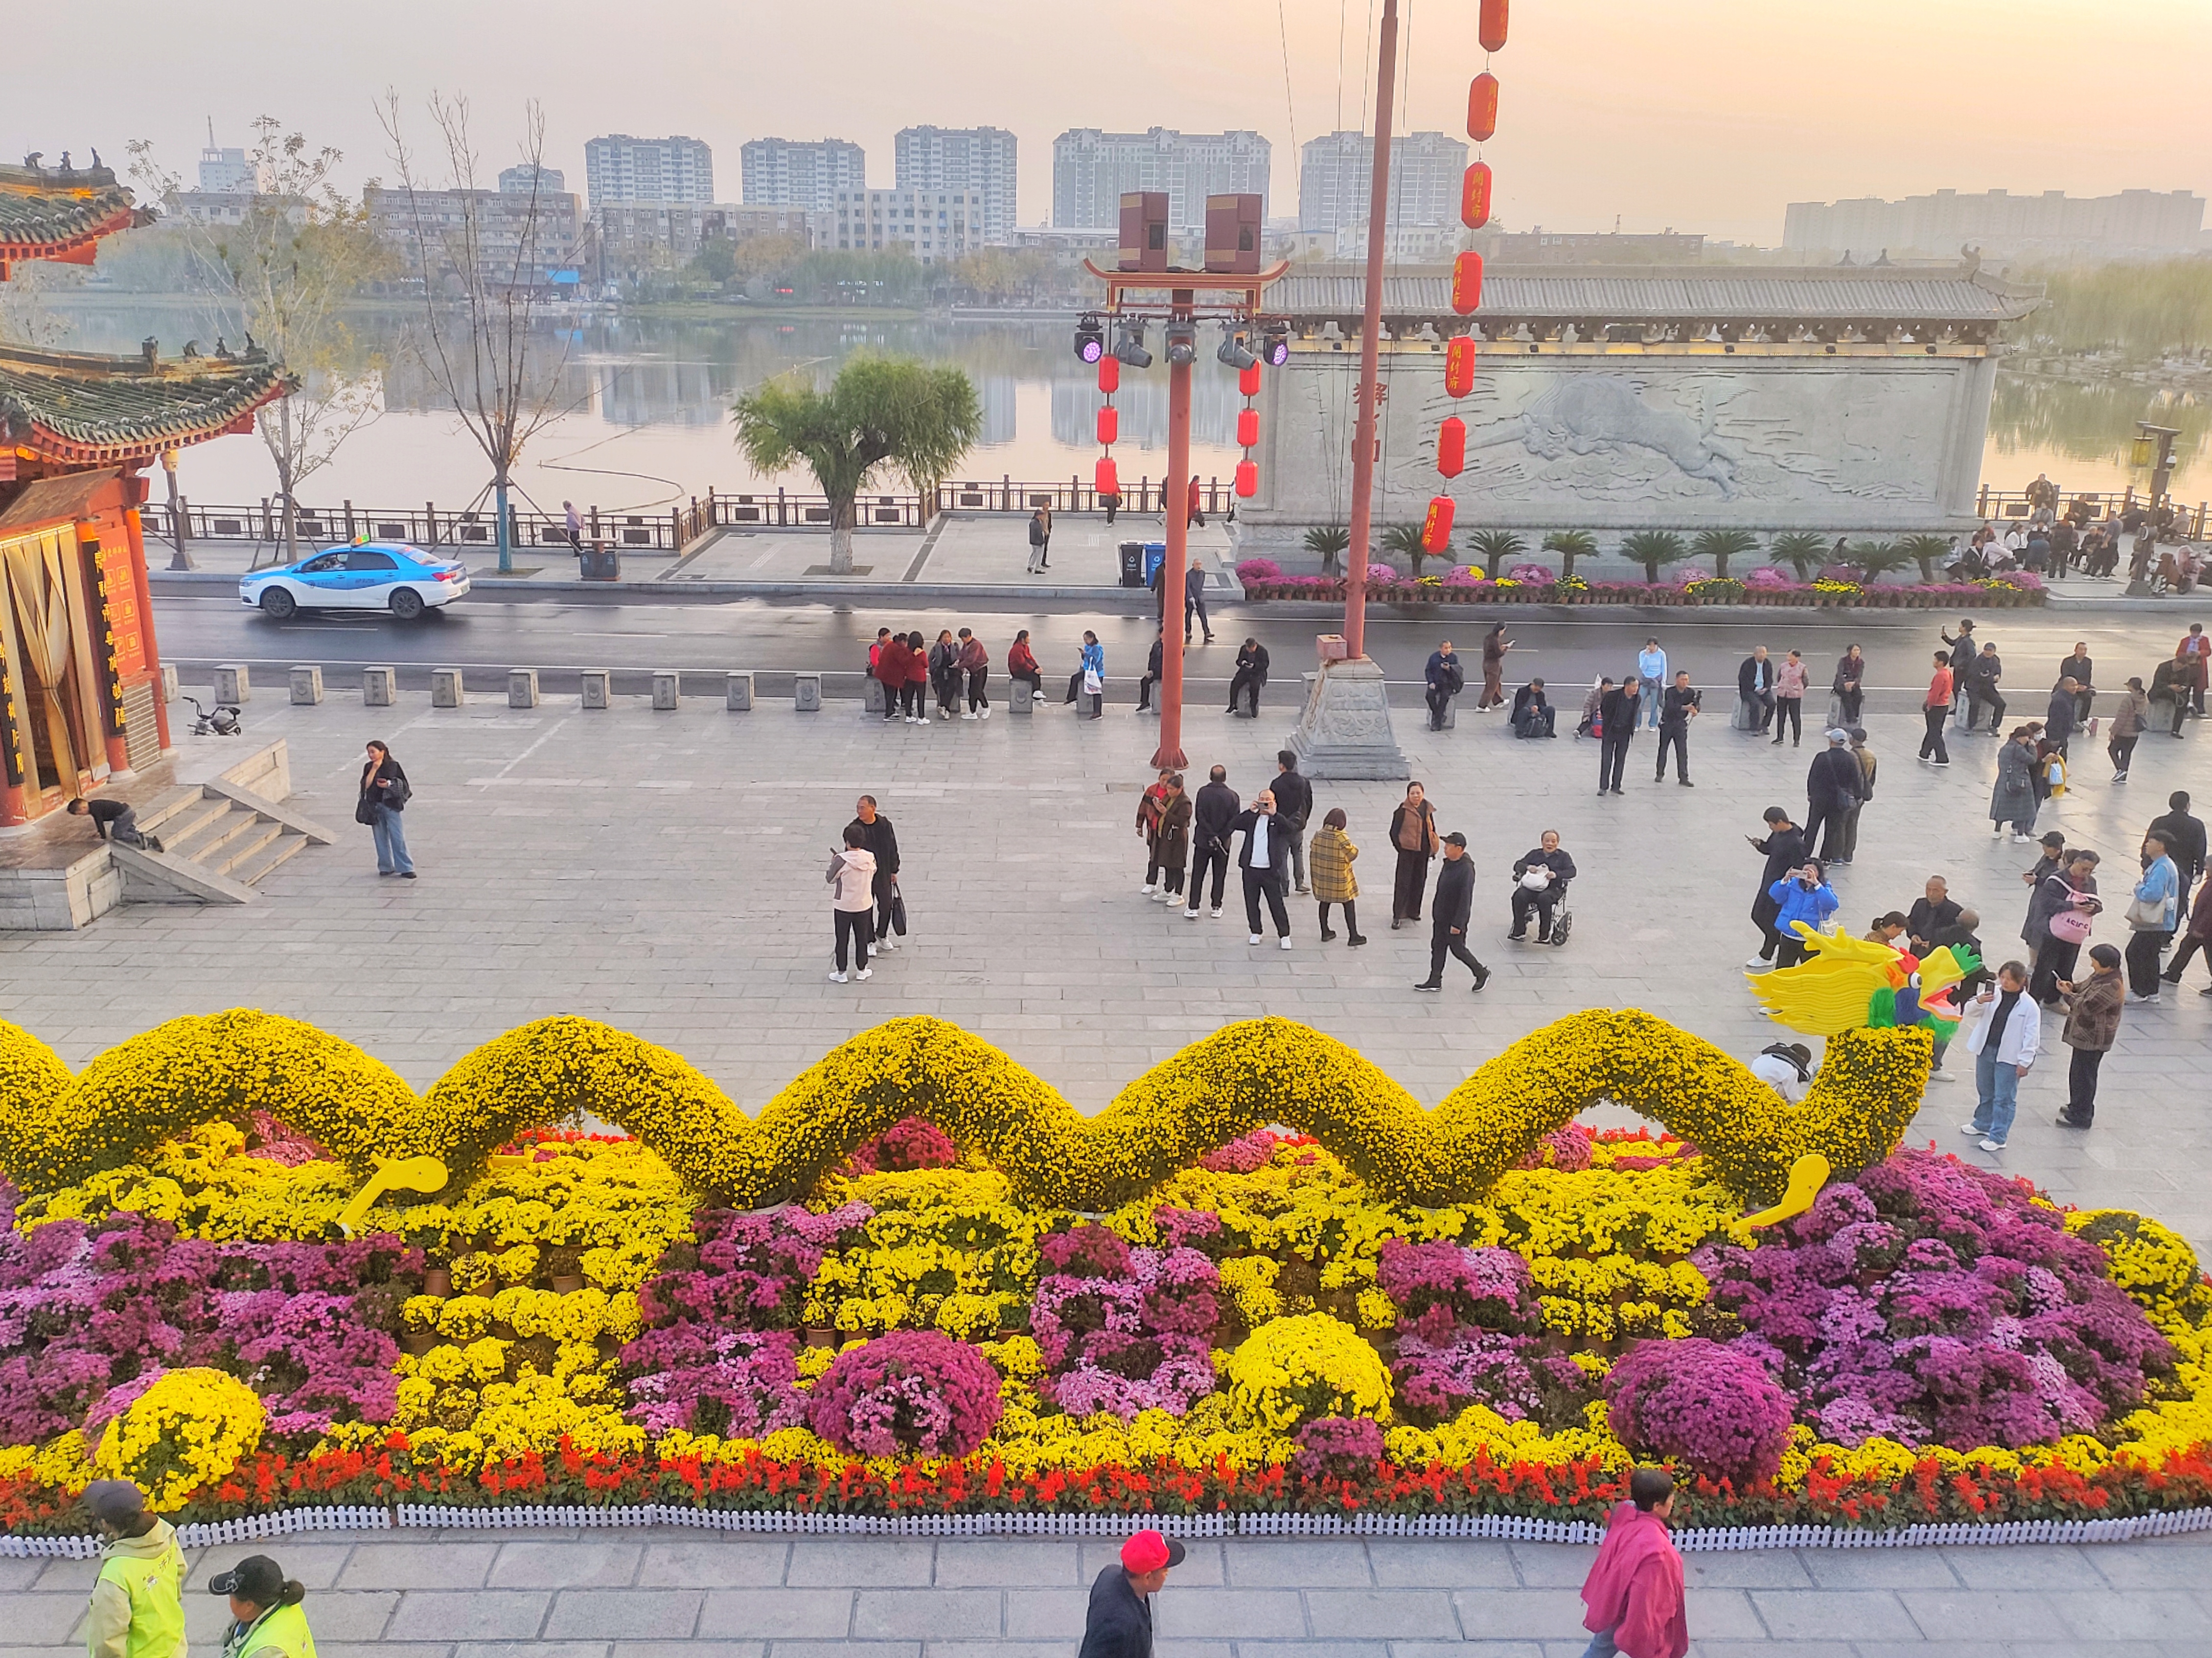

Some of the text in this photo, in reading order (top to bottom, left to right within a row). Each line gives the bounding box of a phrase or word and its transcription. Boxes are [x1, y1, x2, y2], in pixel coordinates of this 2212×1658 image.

[1471, 171, 1483, 218] 開封府
[1448, 345, 1462, 390] 開封府
[1423, 504, 1438, 546] 開封府
[2066, 918, 2088, 930] ASICS
